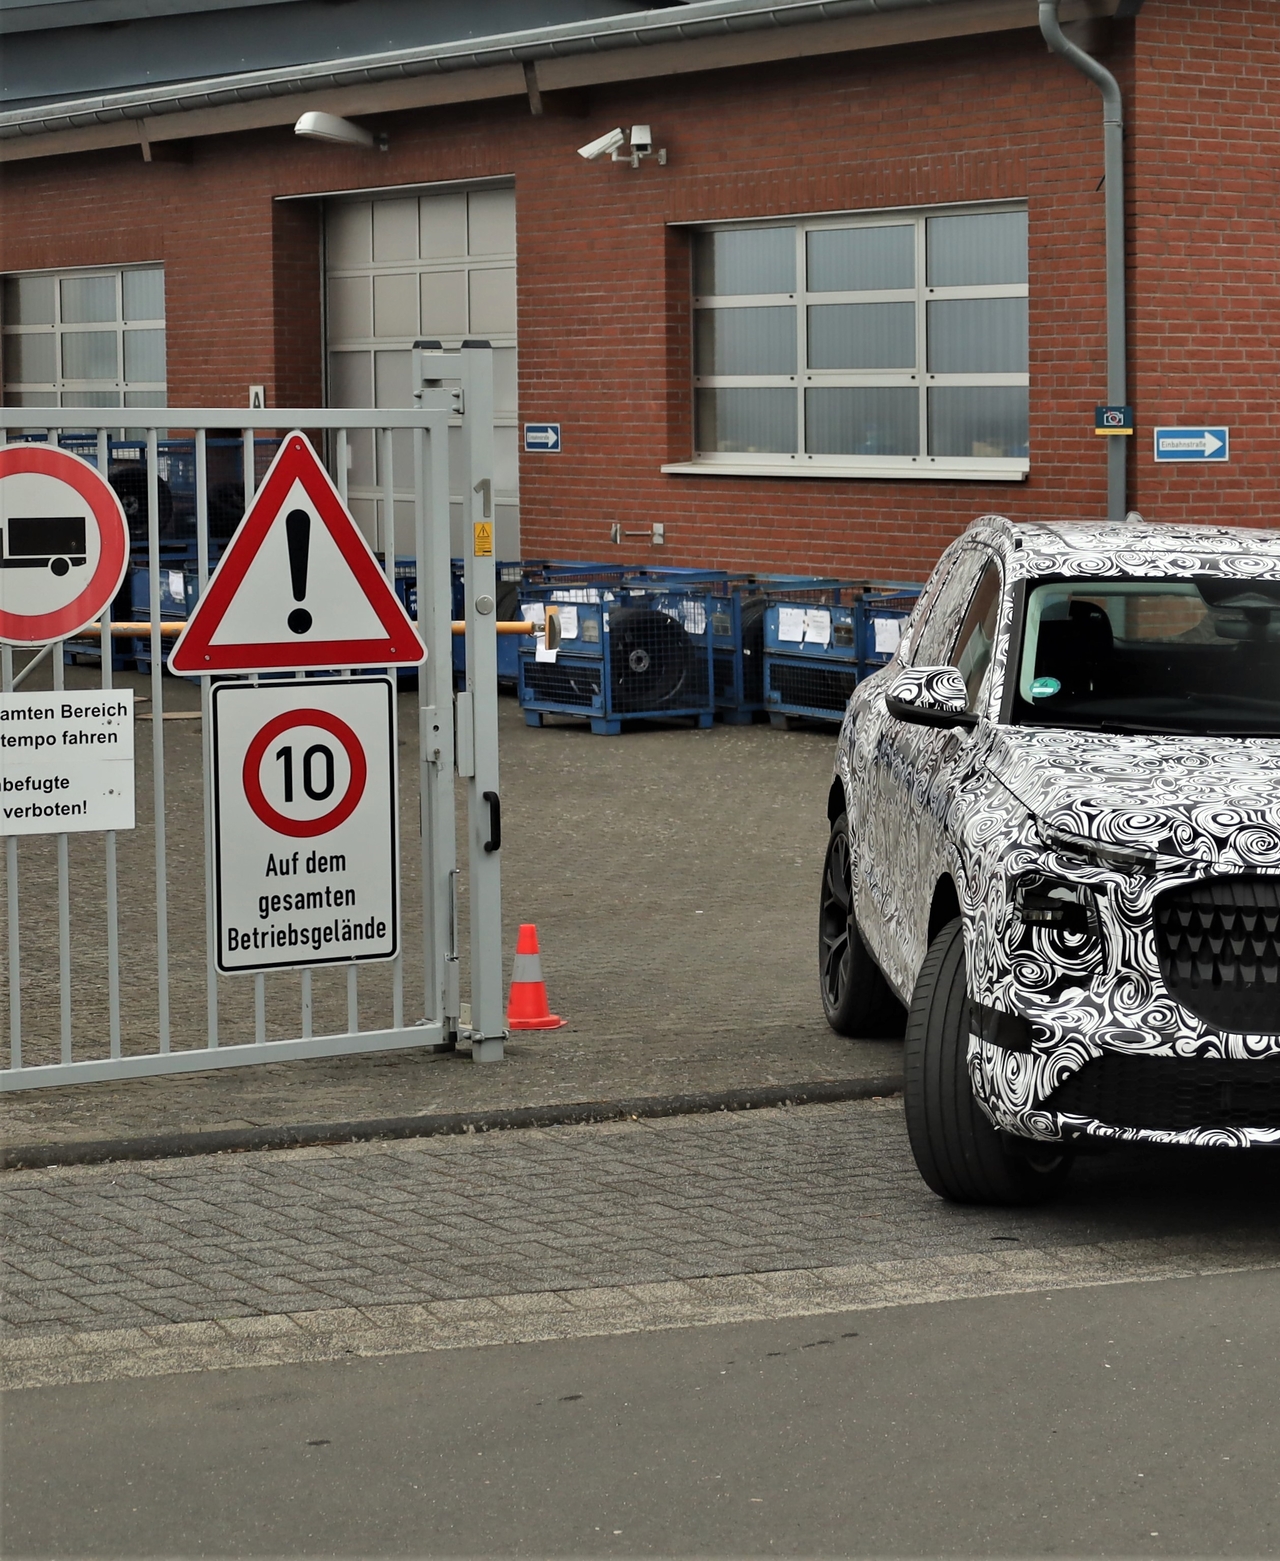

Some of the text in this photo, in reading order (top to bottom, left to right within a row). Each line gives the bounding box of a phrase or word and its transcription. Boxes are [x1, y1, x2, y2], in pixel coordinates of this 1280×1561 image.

[253, 391, 261, 408] A
[1161, 440, 1207, 449] Einbahnstraße
[473, 478, 491, 518] 1
[0, 702, 128, 721] amten Bereich
[1, 730, 118, 750] tempo fahren
[276, 744, 334, 802] 10
[0, 776, 70, 794] befugte
[3, 800, 87, 818] verboten!
[265, 850, 346, 877] Auf dem
[258, 886, 356, 919] gesamten
[228, 916, 386, 951] Betriebsgelände
